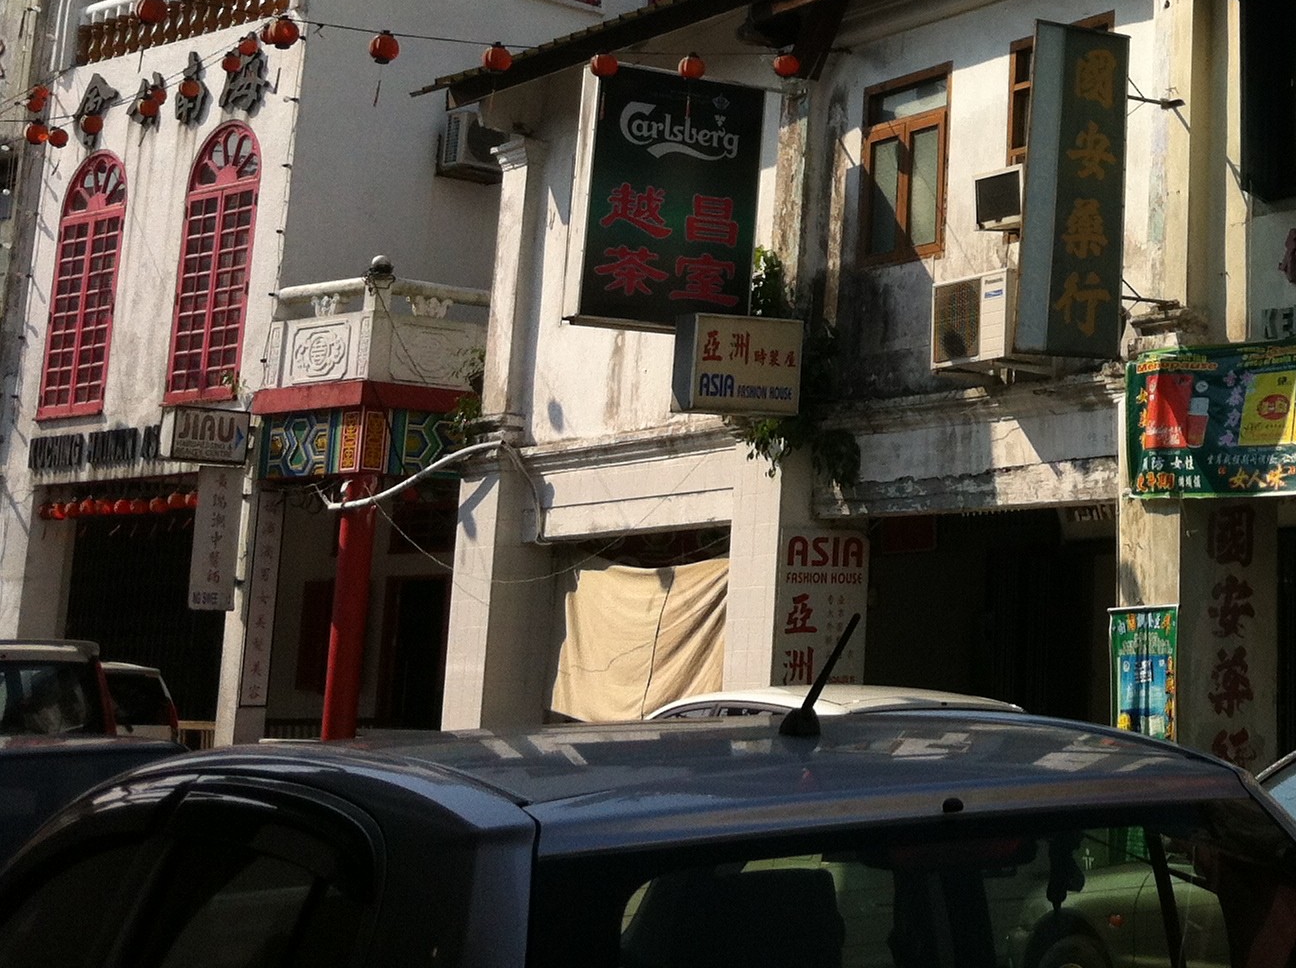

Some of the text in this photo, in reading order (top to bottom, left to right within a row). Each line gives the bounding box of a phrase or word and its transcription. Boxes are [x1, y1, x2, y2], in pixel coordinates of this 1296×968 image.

[619, 100, 741, 161] Carlsberg
[599, 182, 740, 249] 越昌
[594, 246, 740, 308] 茶室
[702, 330, 750, 365] 亞洲
[1135, 360, 1219, 375] Menopause
[699, 373, 793, 401] ASIA FASHION HOUSE
[178, 412, 235, 443] JIAU
[28, 432, 85, 469] KUCHING
[786, 535, 864, 568] ASIA
[786, 572, 863, 585] FASHION HOUSE
[783, 593, 818, 685] 亞洲
